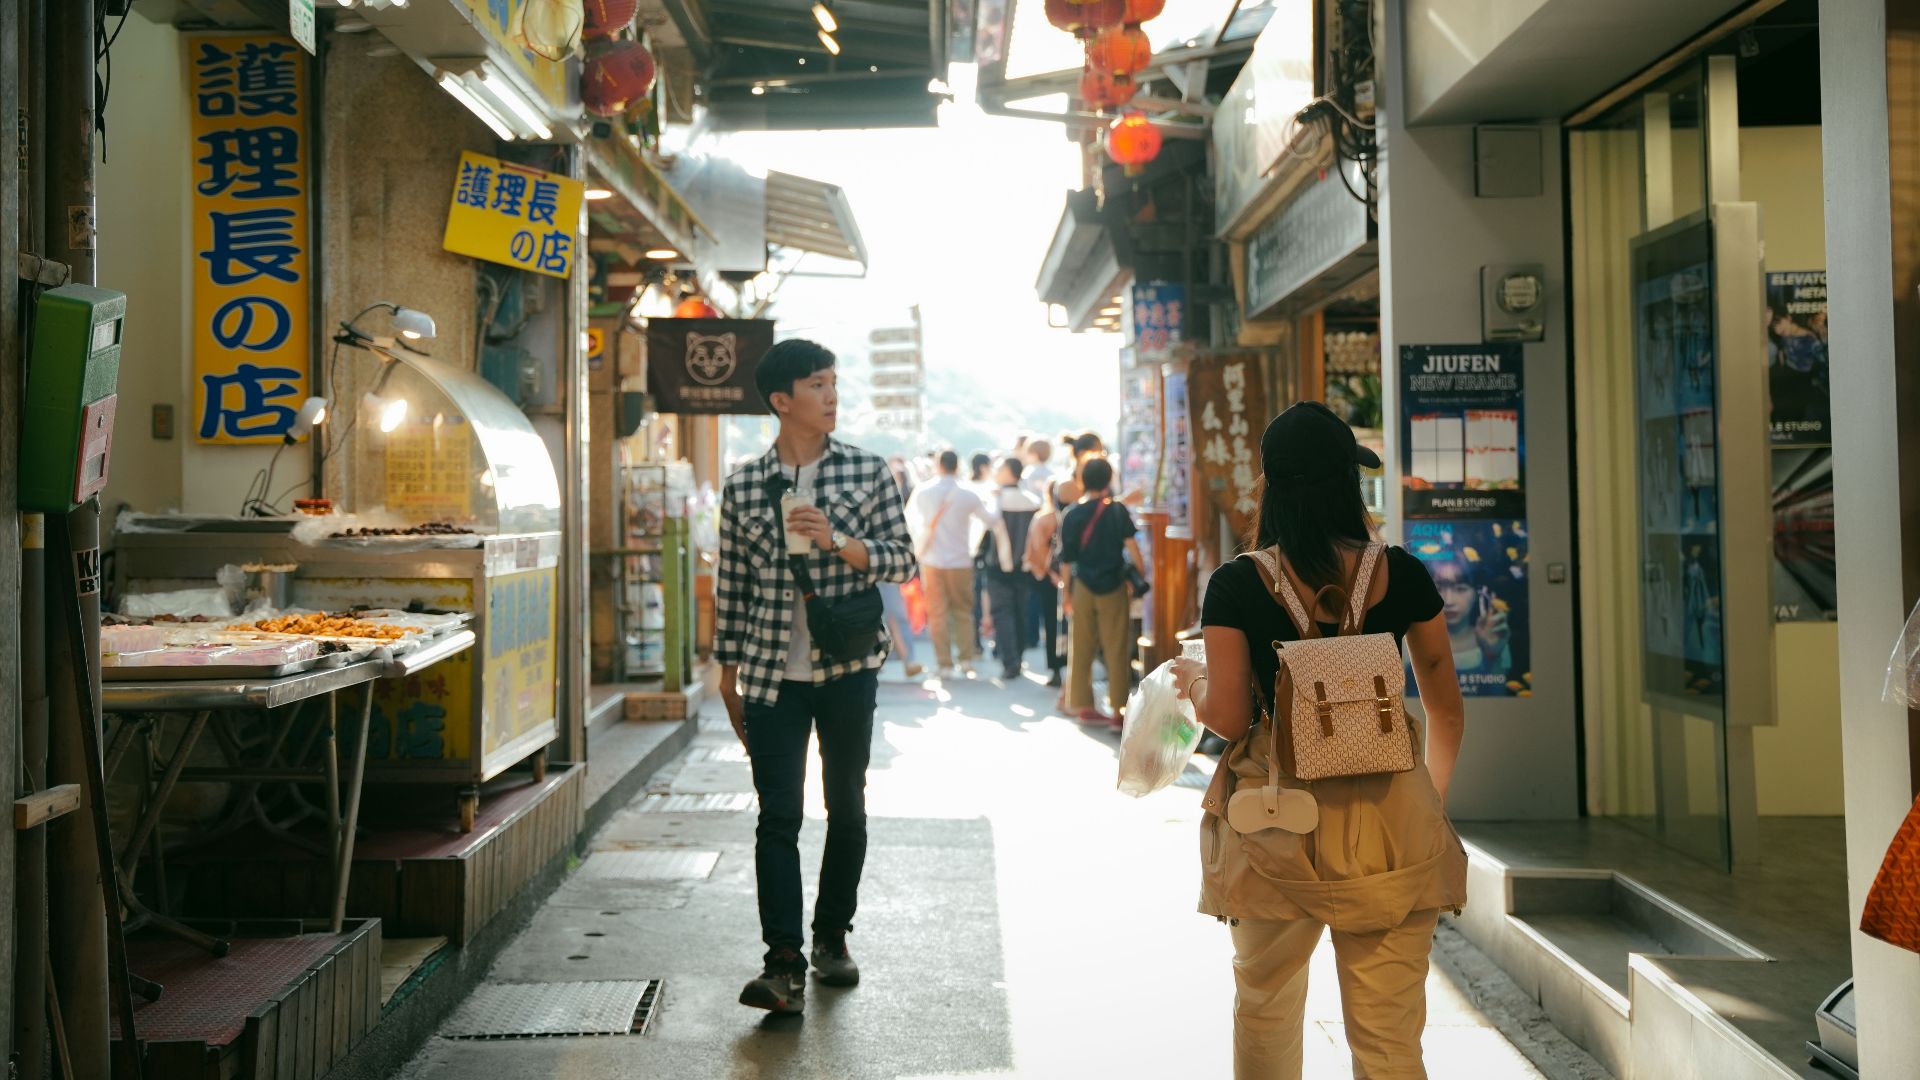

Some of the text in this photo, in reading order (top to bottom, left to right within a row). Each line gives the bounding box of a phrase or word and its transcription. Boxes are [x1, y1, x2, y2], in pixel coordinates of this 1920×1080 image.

[457, 161, 560, 226] 護理長
[197, 42, 301, 438] 護理長の店
[511, 230, 572, 273] の店
[1423, 354, 1500, 373] JIUFEN
[1410, 374, 1517, 391] NEW FRAME
[1463, 498, 1496, 507] STUDIO
